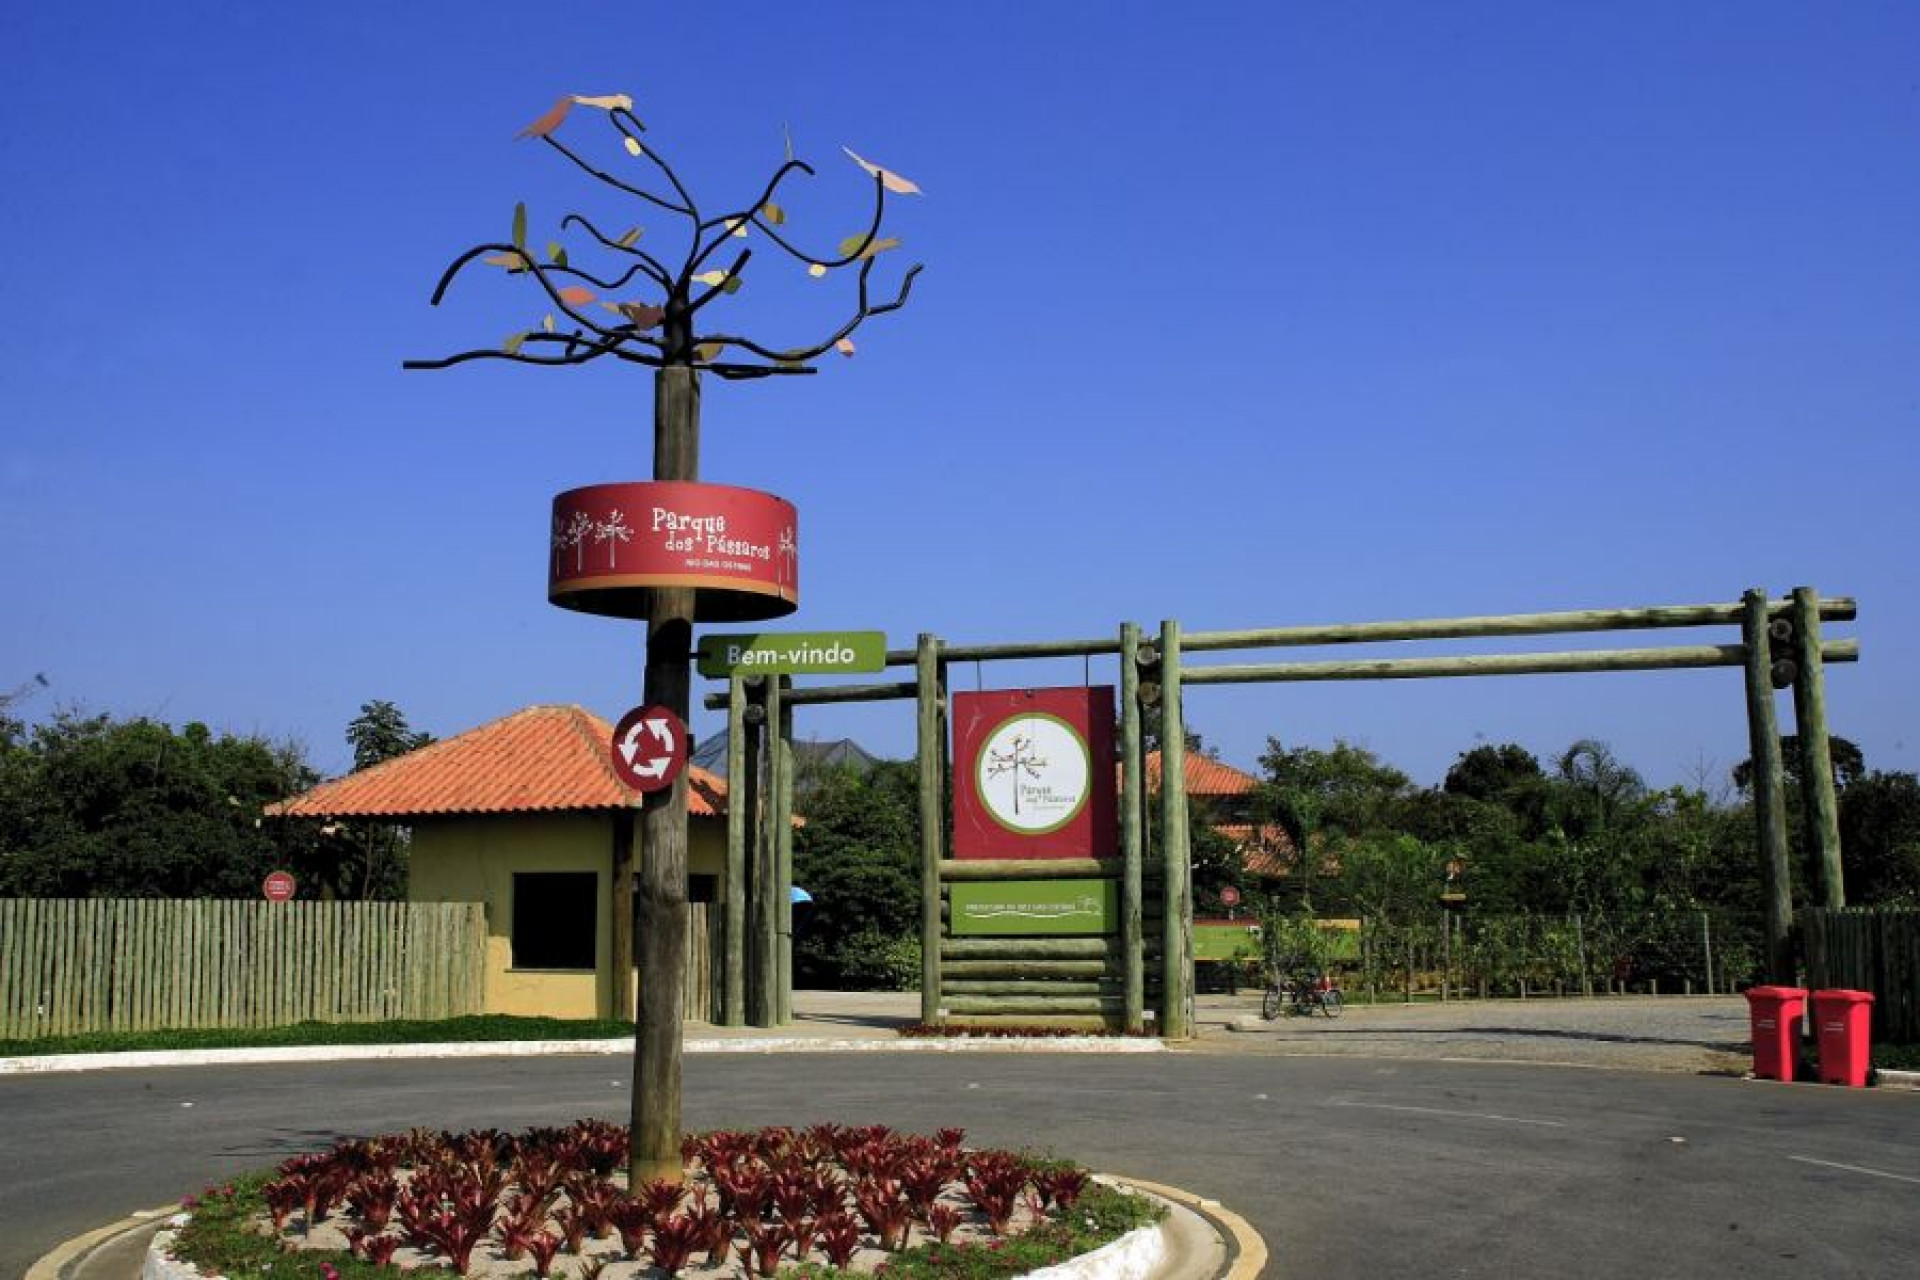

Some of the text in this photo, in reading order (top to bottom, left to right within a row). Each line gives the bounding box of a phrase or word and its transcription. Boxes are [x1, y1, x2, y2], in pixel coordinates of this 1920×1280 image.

[652, 507, 726, 541] Parque
[665, 531, 693, 552] dos
[727, 641, 856, 665] Bem-vindo
